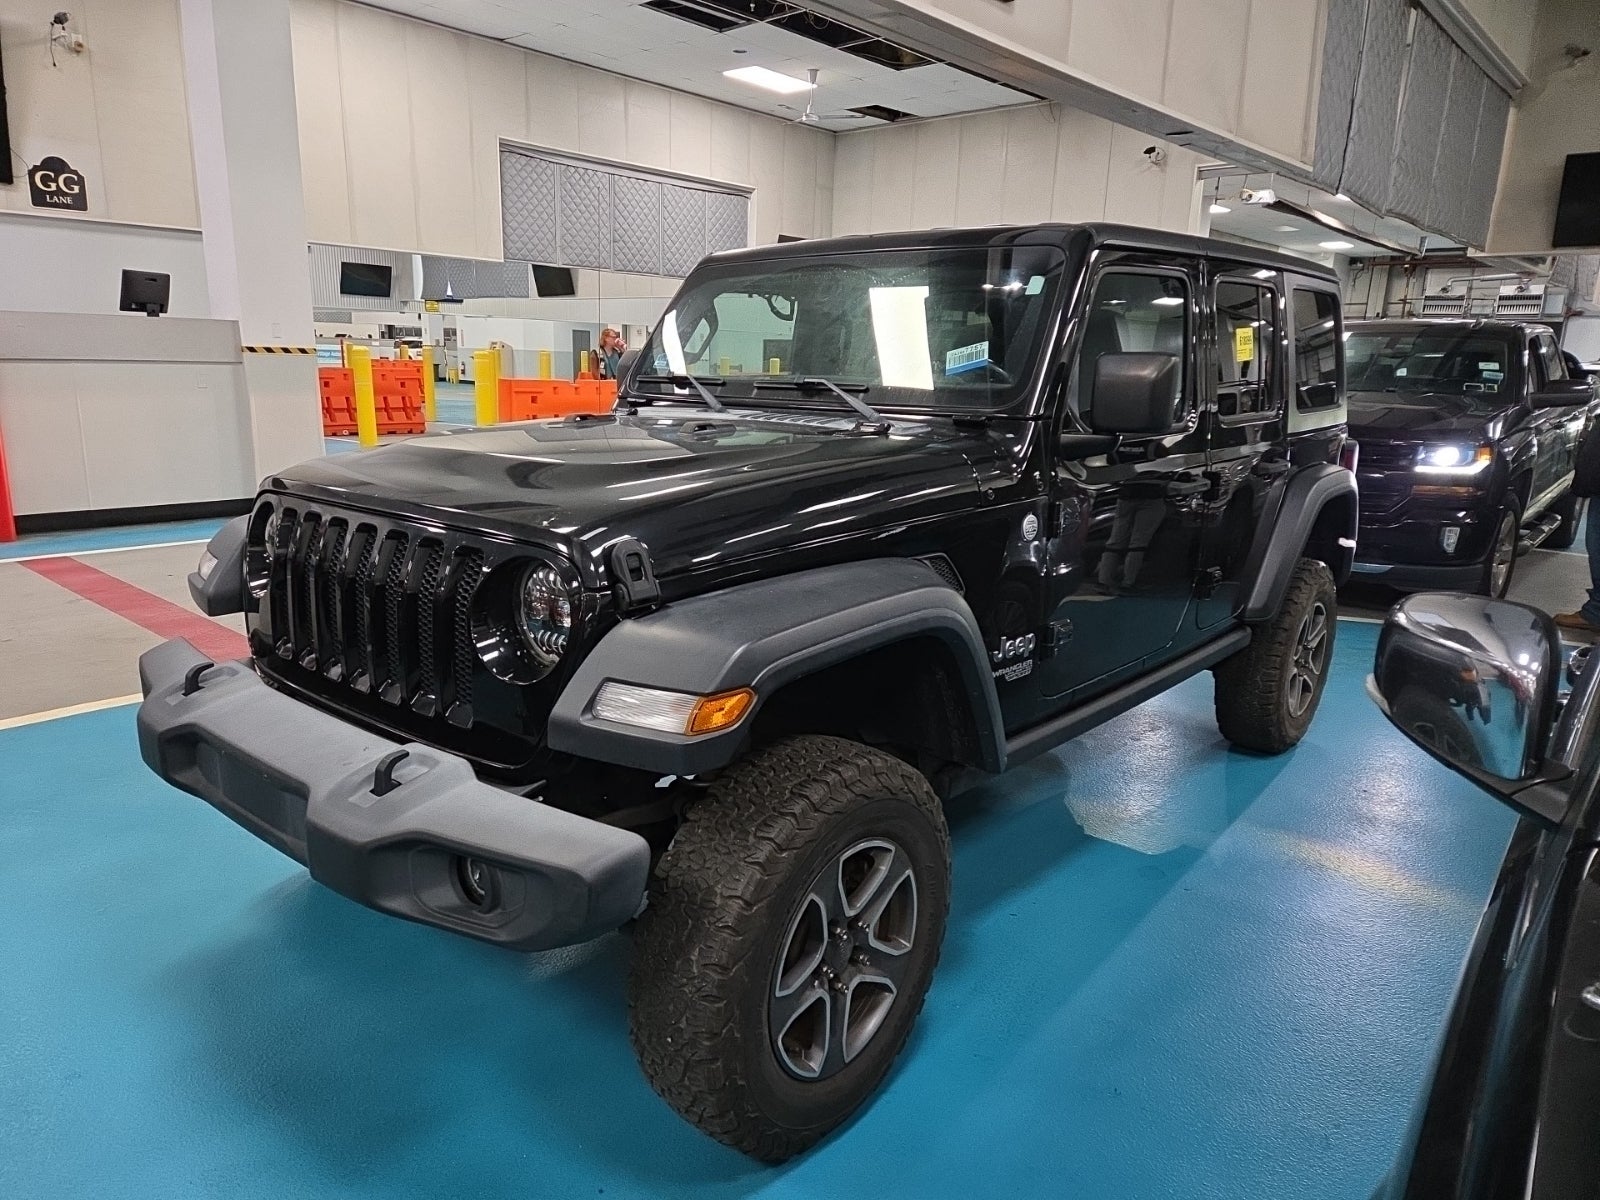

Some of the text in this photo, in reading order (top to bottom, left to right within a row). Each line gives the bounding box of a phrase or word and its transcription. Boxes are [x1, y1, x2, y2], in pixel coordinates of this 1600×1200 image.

[35, 171, 80, 193] GG
[46, 194, 73, 204] LANE
[993, 633, 1036, 662] Jeep
[992, 659, 1033, 678] WRANGLER
